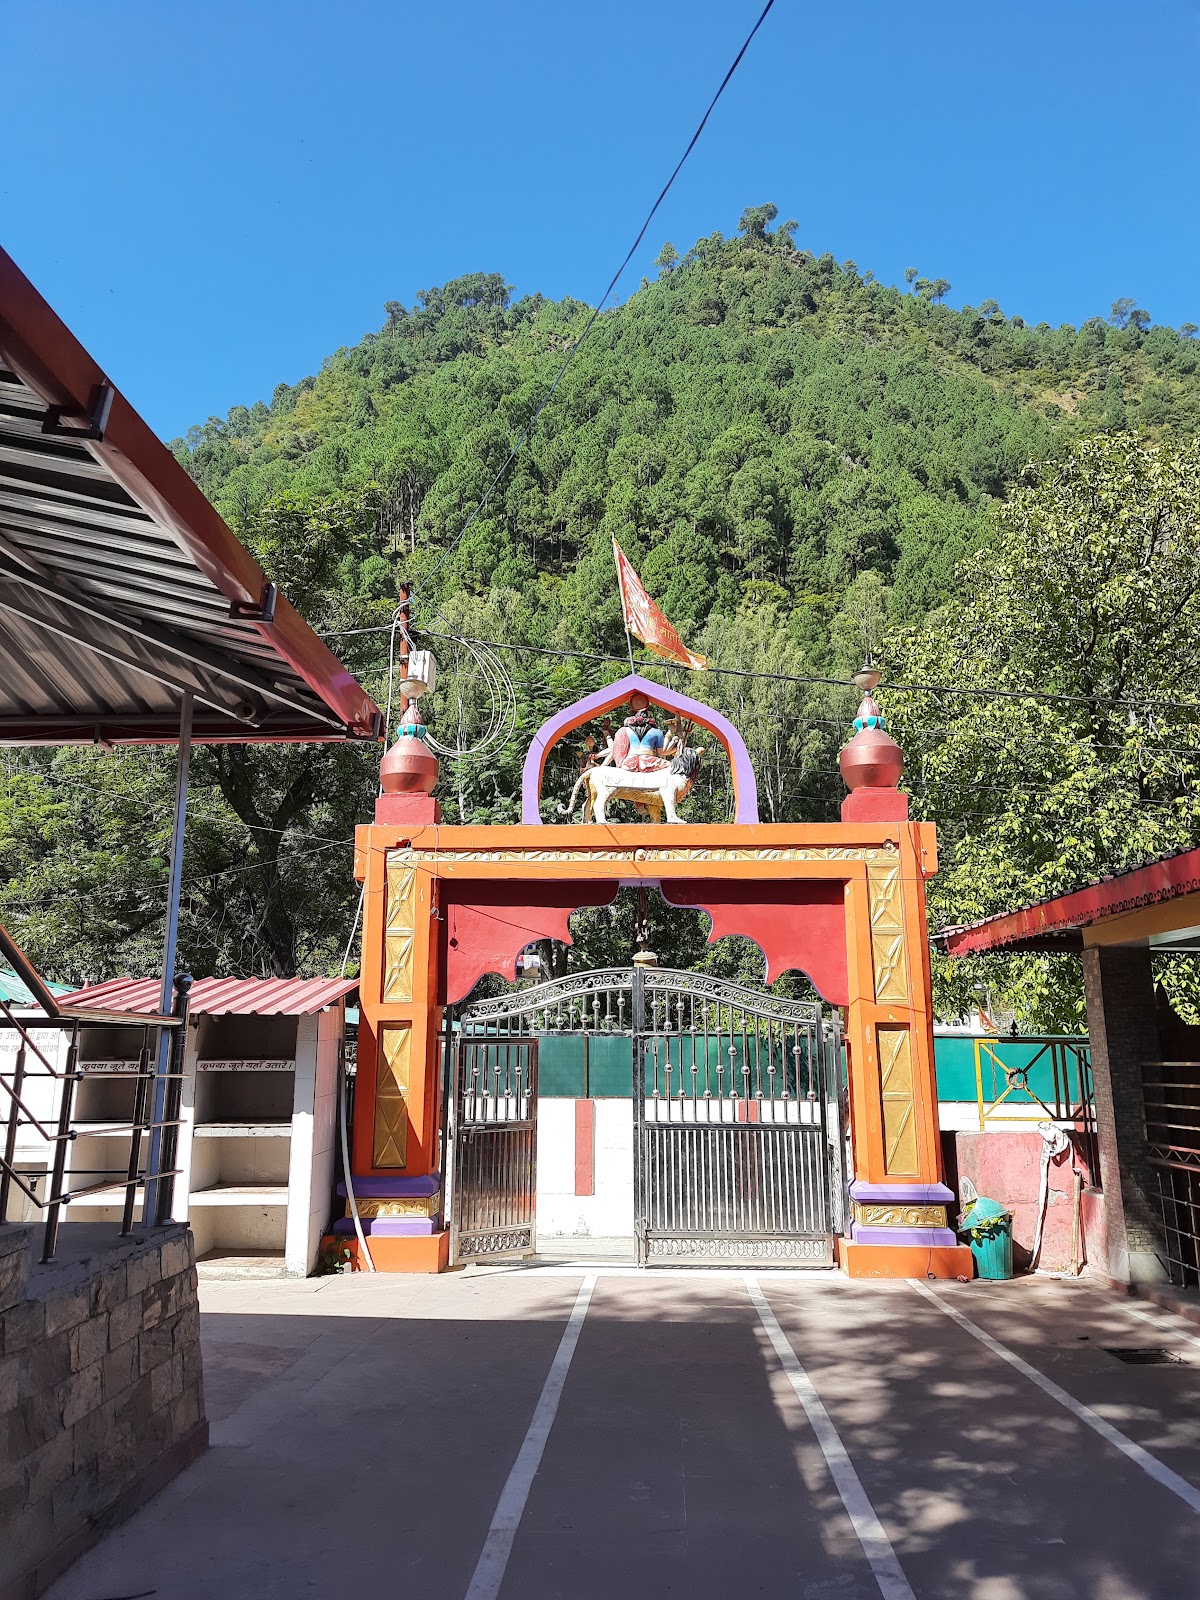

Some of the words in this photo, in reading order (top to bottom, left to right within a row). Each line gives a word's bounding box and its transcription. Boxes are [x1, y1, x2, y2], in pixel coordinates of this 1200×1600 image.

[660, 626, 677, 642] माता
[81, 1063, 107, 1071] कृपया
[109, 1060, 126, 1072] जूते
[200, 1062, 226, 1071] कृपया
[228, 1060, 244, 1071] जूते
